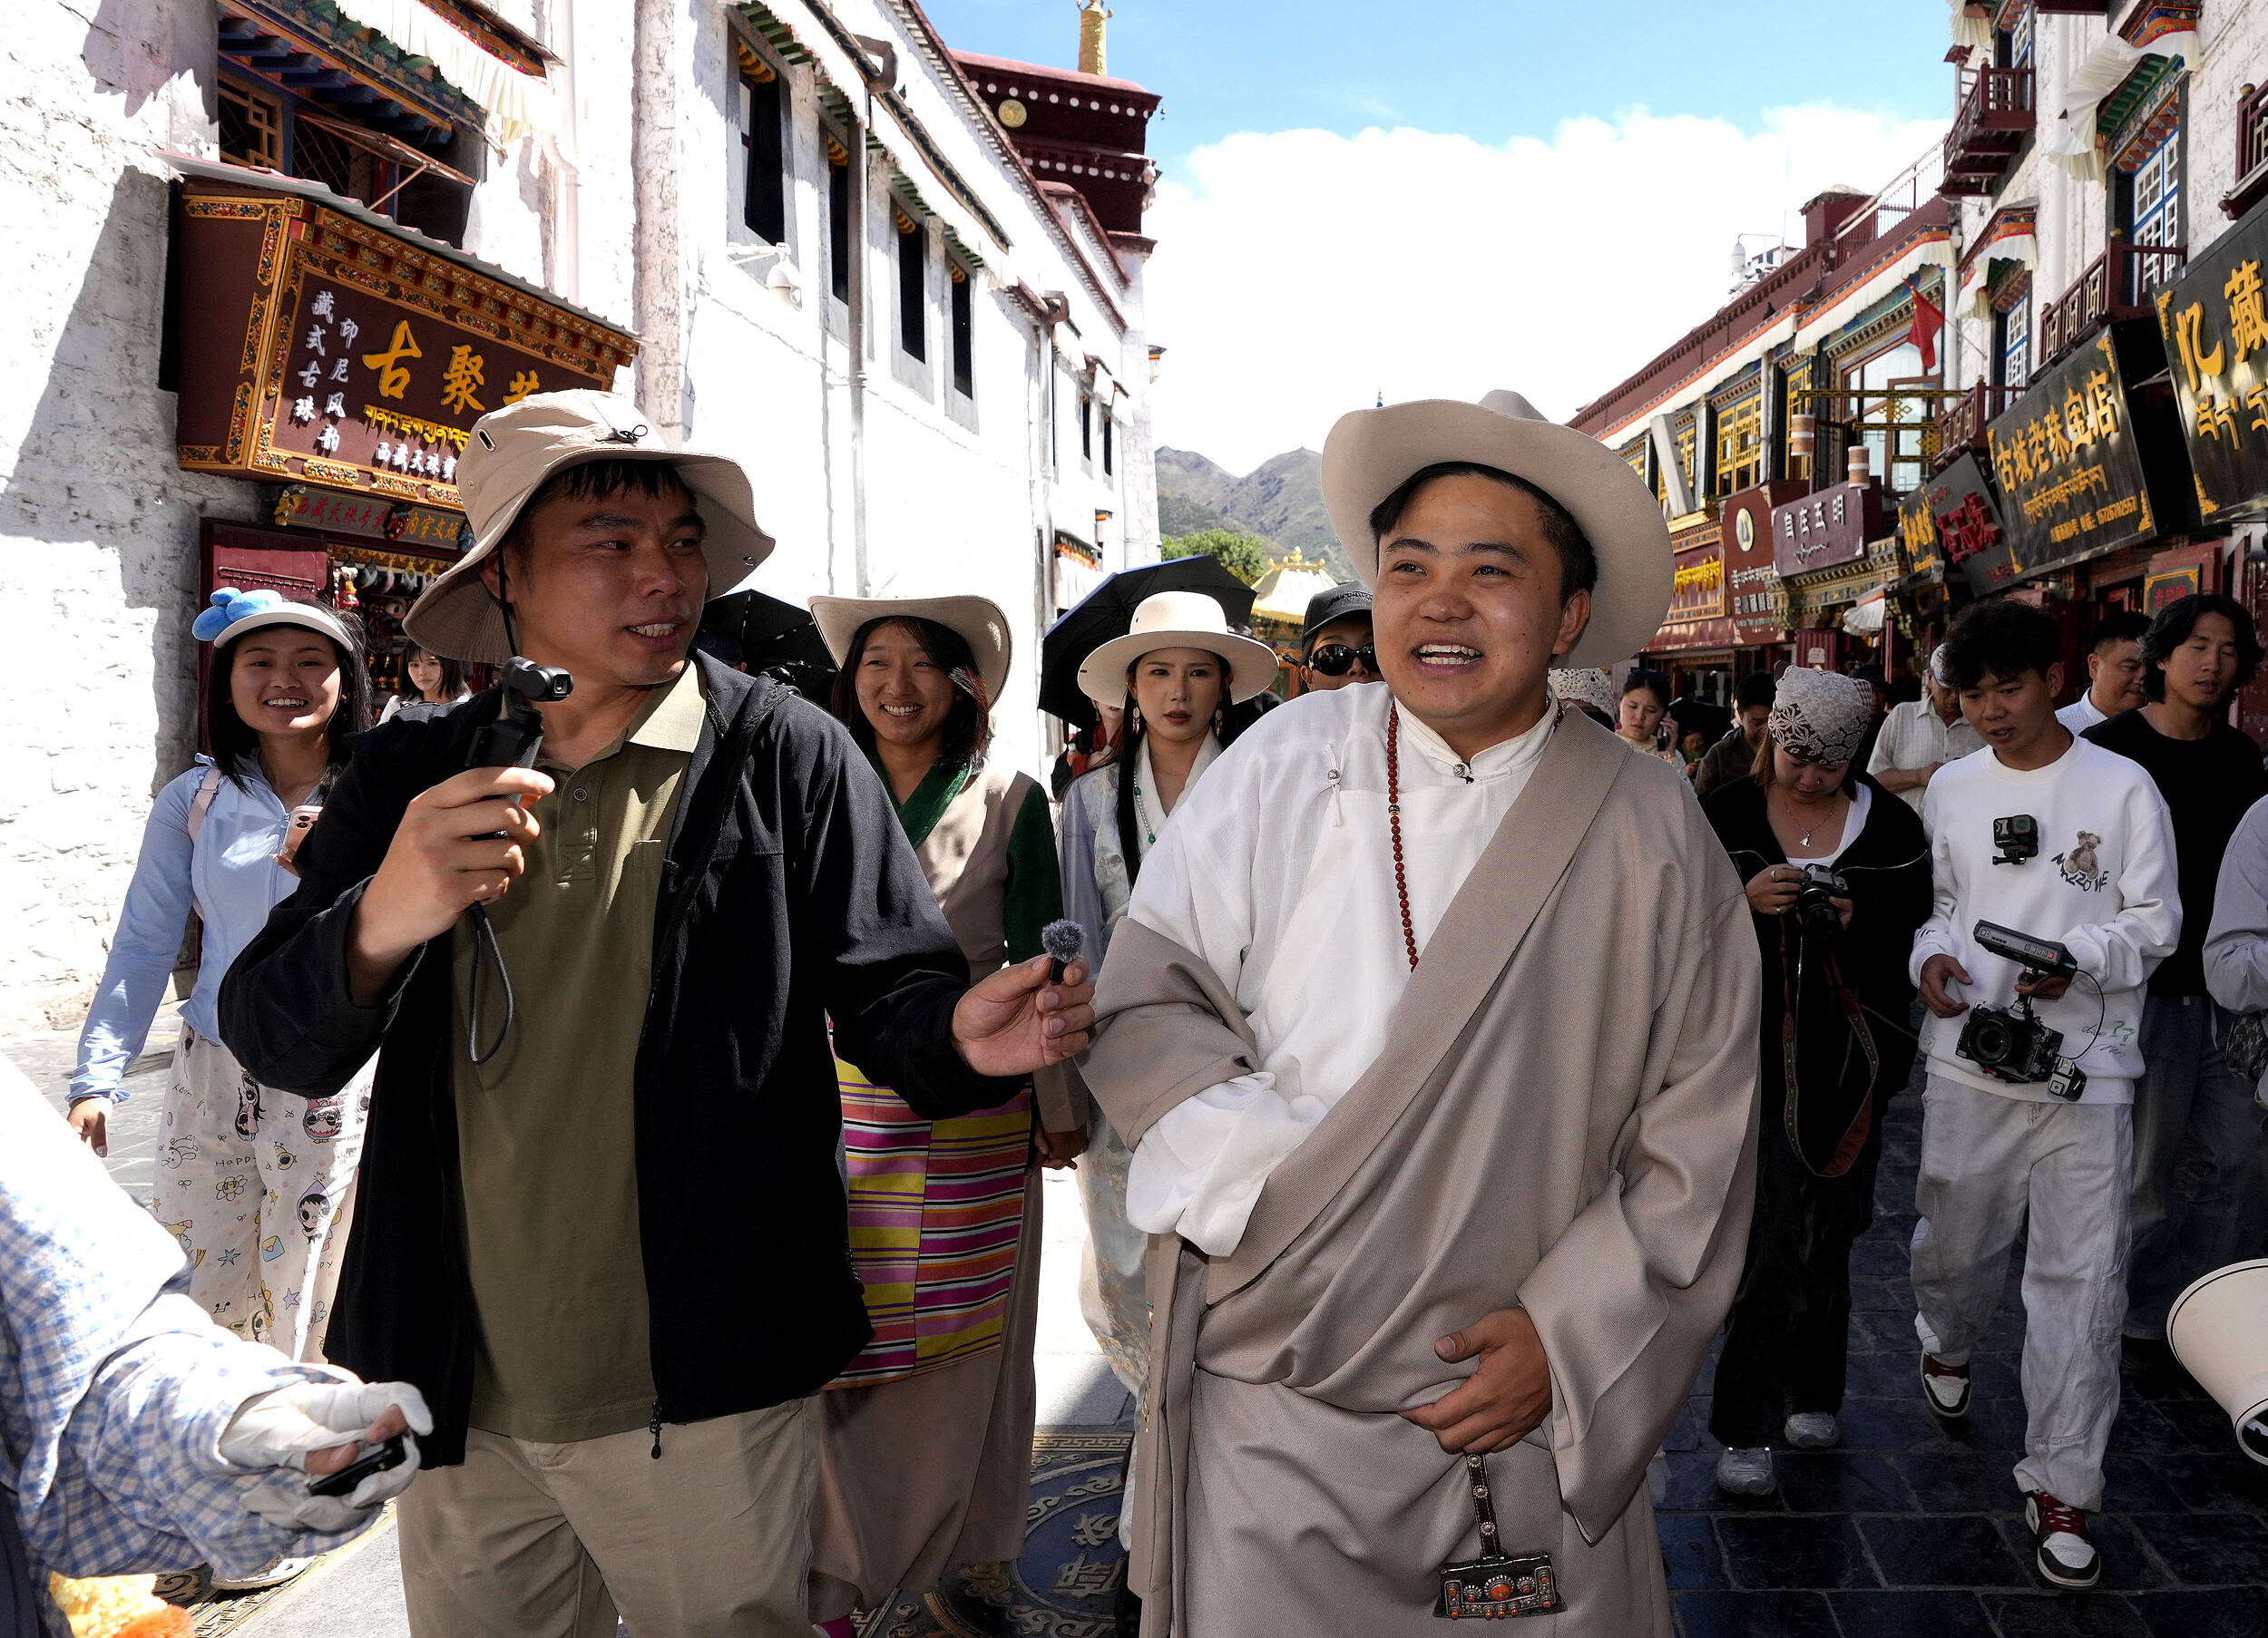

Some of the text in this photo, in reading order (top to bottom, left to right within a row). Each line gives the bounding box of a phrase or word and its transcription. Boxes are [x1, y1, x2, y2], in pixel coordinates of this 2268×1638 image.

[294, 290, 335, 422] 藏式古珠
[318, 317, 359, 452] 印尼风韵
[1996, 369, 2118, 493] 古城老珠宝店
